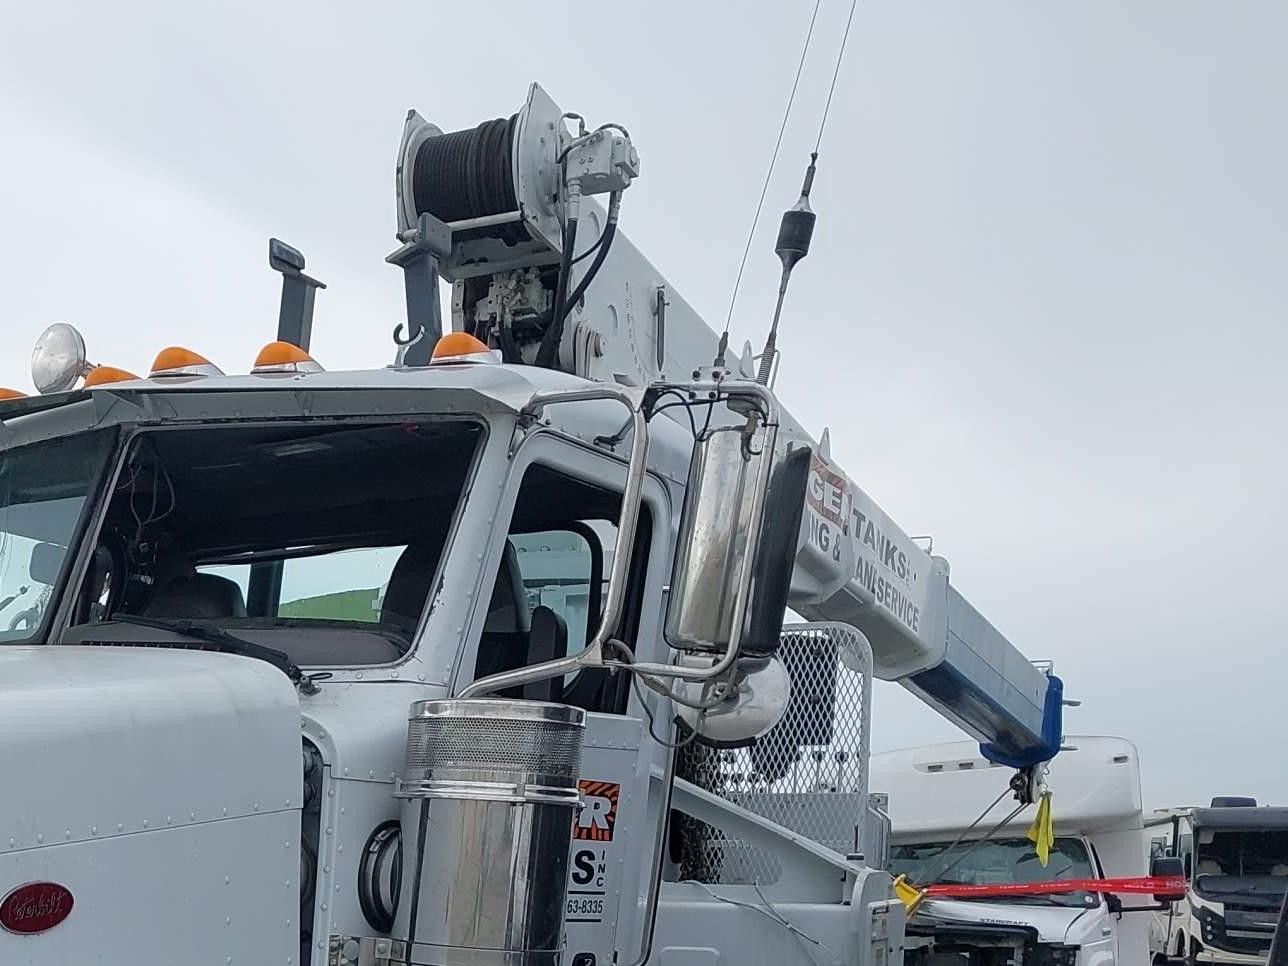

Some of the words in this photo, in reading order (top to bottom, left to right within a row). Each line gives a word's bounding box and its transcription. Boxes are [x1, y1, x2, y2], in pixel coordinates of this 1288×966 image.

[853, 509, 907, 580] TANKS
[832, 534, 841, 562] &
[876, 578, 920, 632] SERVICE
[571, 849, 596, 885] S
[596, 850, 606, 888] INC
[8, 891, 68, 921] Peterbilt
[567, 899, 603, 914] 63-8335
